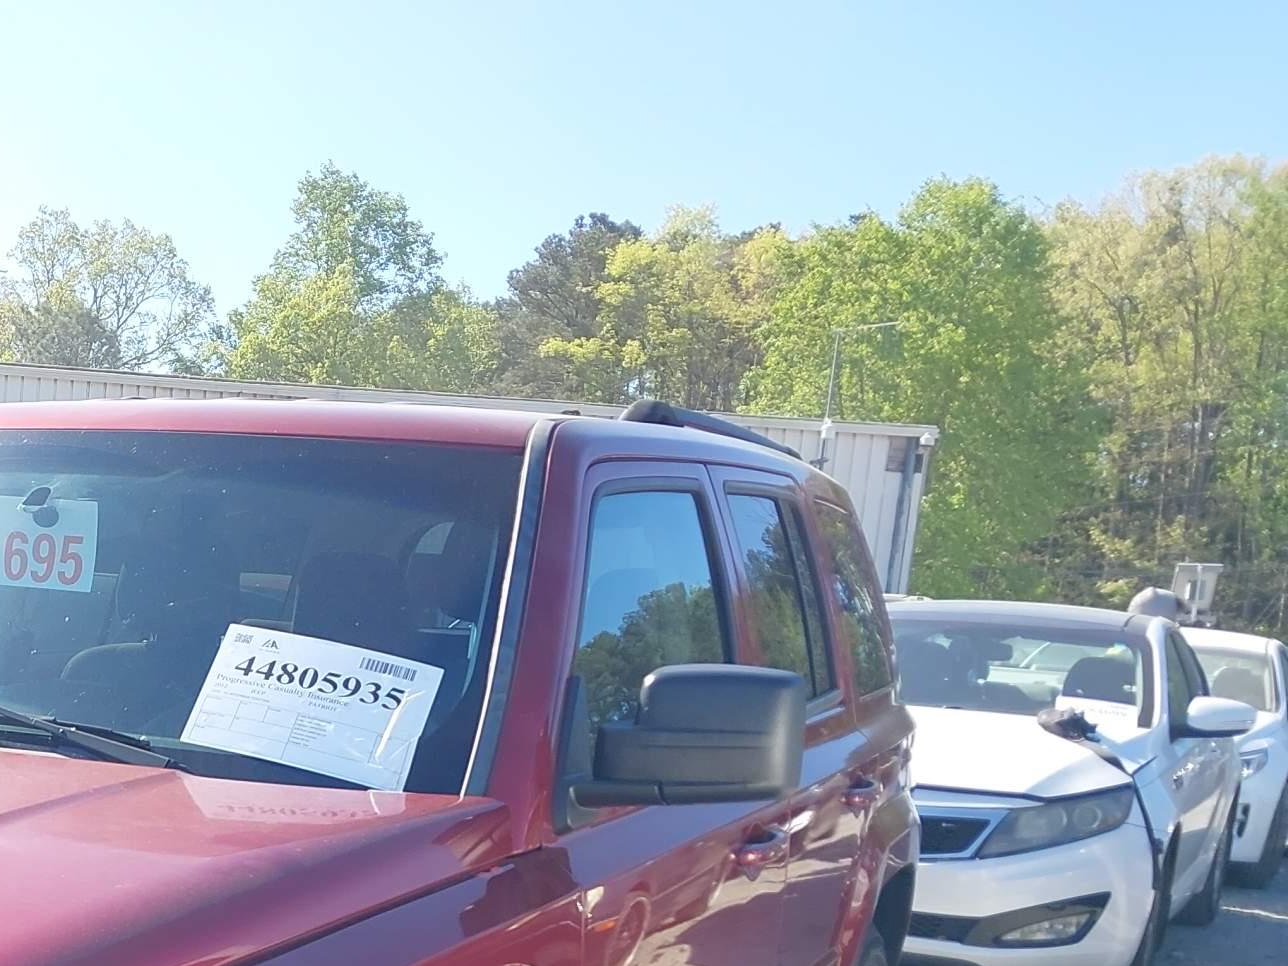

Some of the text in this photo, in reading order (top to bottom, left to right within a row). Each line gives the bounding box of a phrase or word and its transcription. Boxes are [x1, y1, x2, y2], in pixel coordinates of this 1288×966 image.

[4, 531, 84, 586] 695
[216, 673, 266, 690] Progressive
[267, 683, 304, 698] Casualty
[307, 691, 350, 707] Insurance
[234, 656, 406, 710] 44805935
